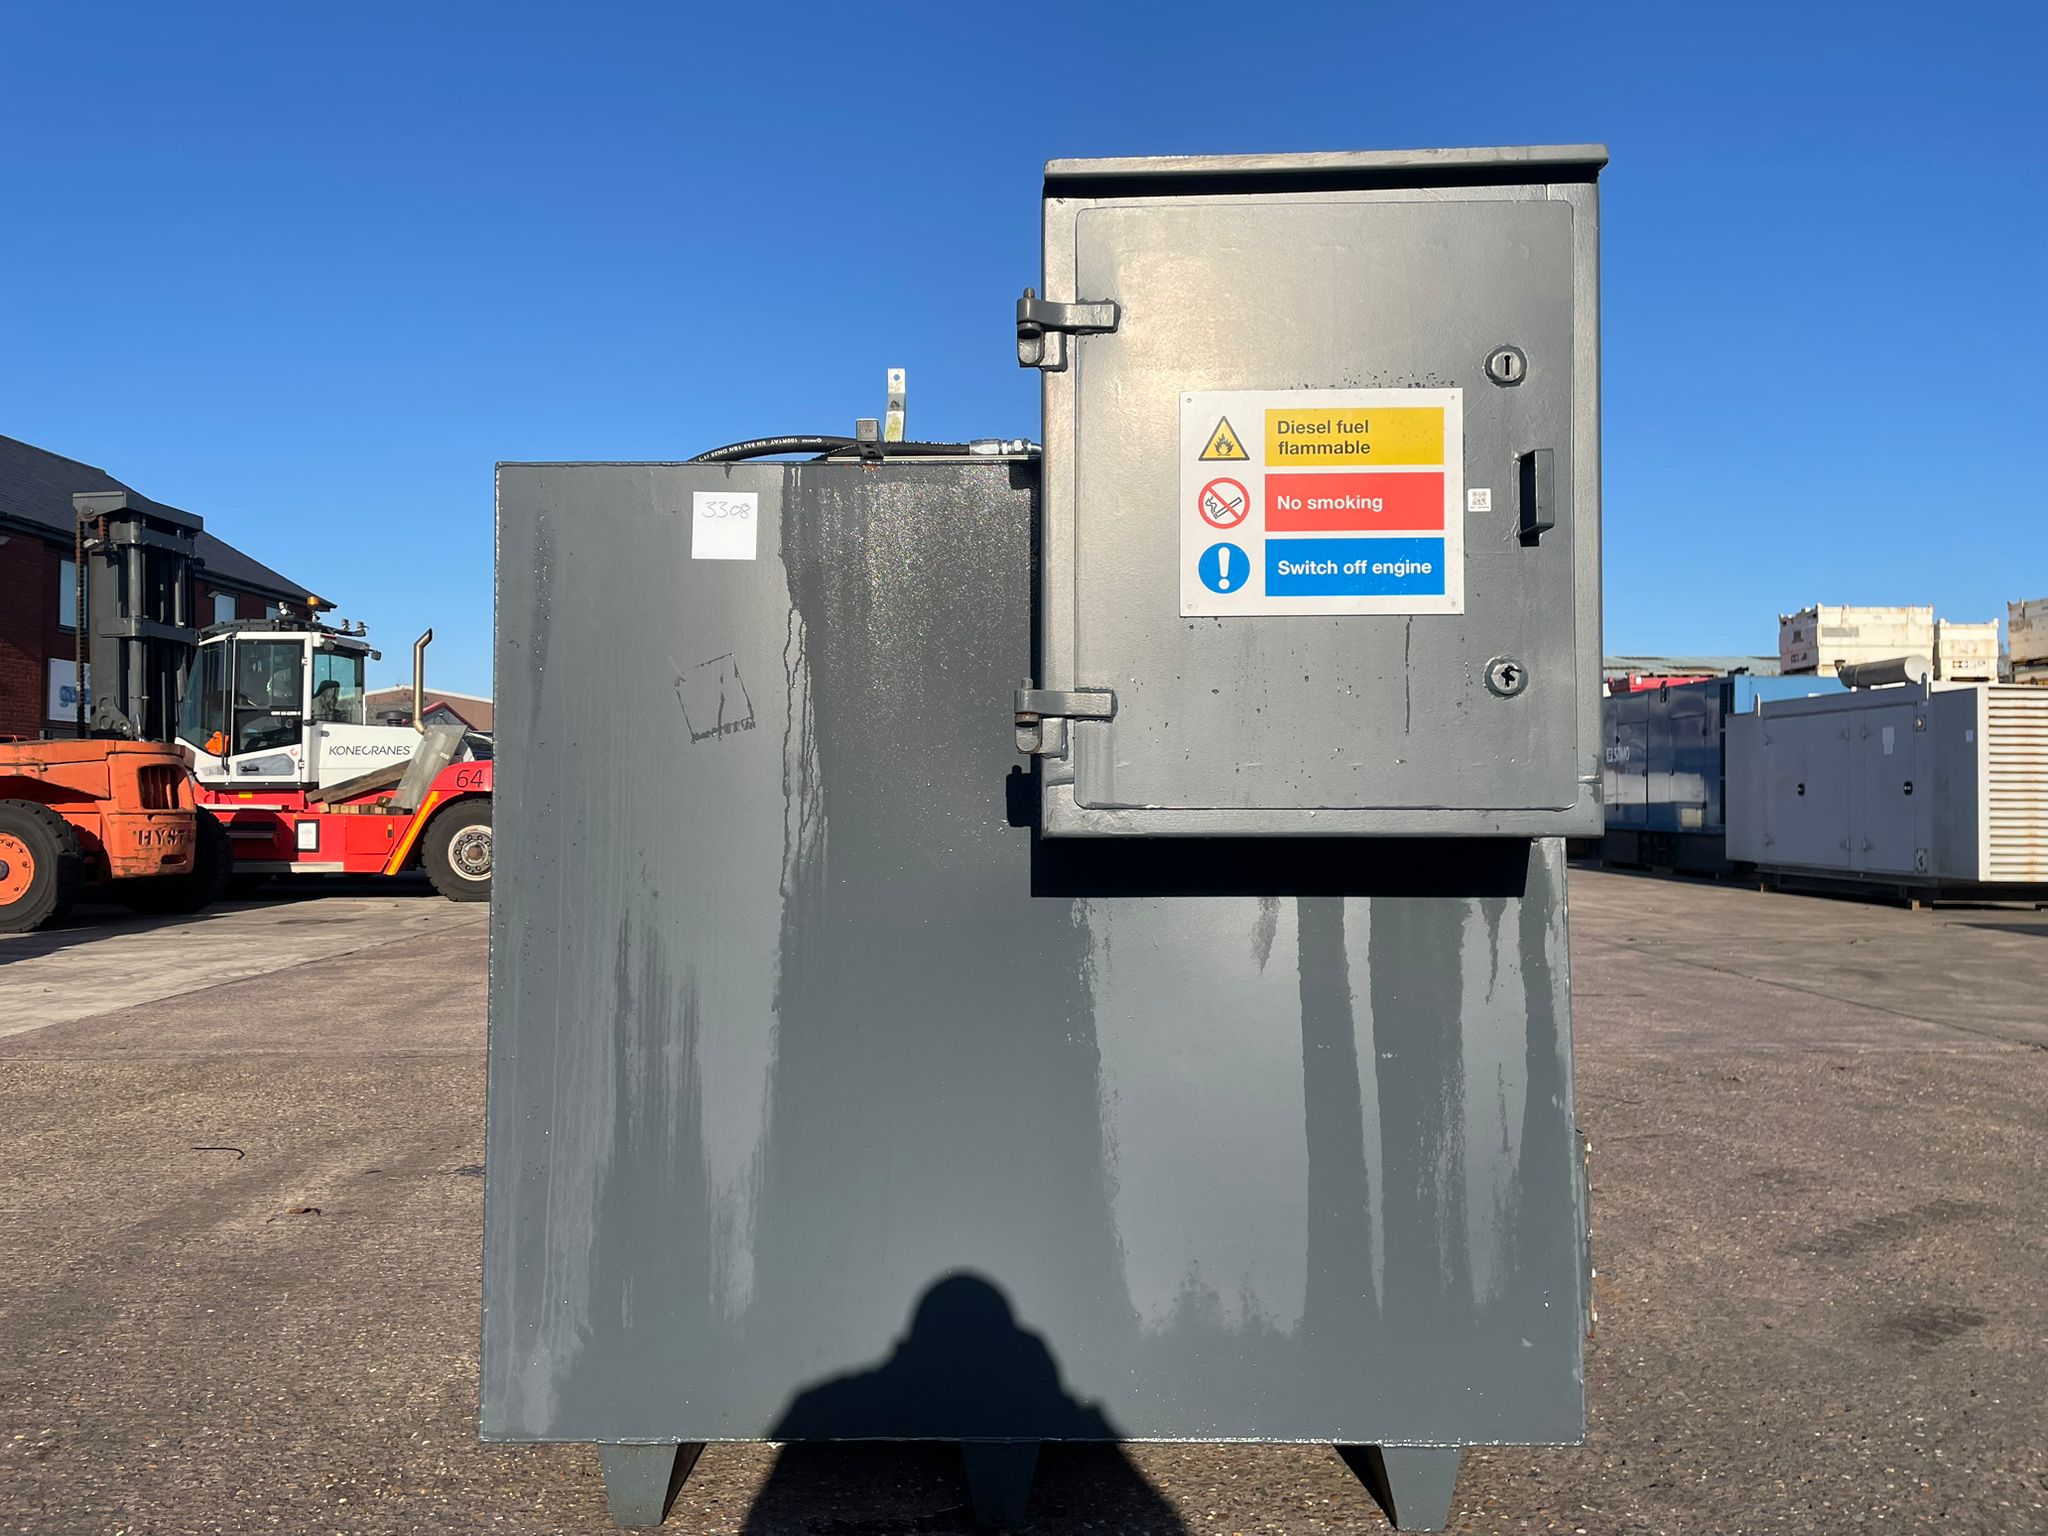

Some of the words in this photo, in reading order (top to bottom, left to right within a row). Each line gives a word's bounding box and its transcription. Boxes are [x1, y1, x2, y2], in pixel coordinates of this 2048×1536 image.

[1277, 420, 1331, 435] Diesel
[1336, 419, 1369, 435] fuel
[1278, 440, 1371, 456] flammable
[701, 501, 751, 519] 3308
[1277, 495, 1302, 511] No
[1307, 494, 1383, 513] smoking
[1277, 559, 1338, 576] Switch
[1343, 559, 1367, 575] off
[1372, 560, 1432, 578] engine
[328, 745, 411, 757] KONECRANES
[456, 769, 484, 789] 64
[138, 830, 193, 845] HYST
